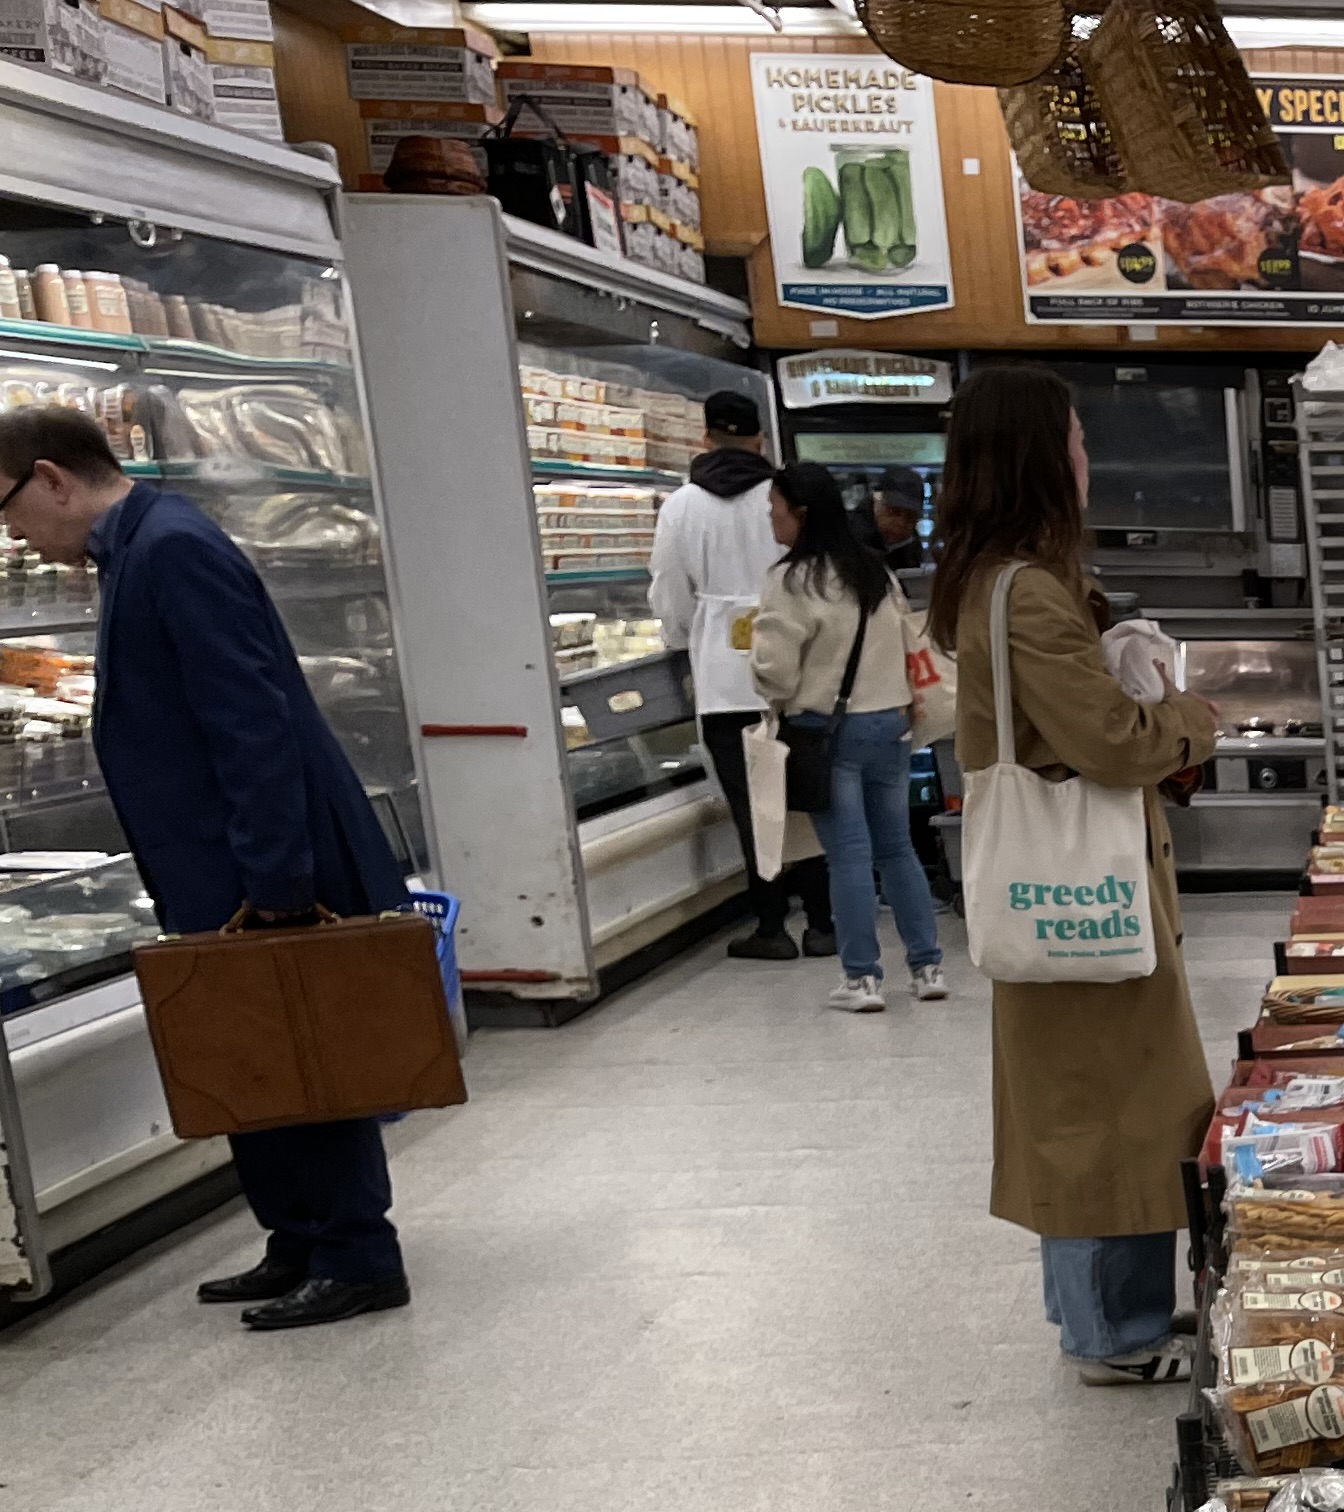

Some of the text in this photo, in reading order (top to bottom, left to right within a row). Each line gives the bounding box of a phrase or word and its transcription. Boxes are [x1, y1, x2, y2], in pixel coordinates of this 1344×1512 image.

[766, 67, 917, 90] HOMEMADE
[792, 93, 897, 114] PICKLES
[791, 118, 914, 134] SAUERKRAUT
[1009, 875, 1137, 911] greedy
[1034, 910, 1141, 941] reads
